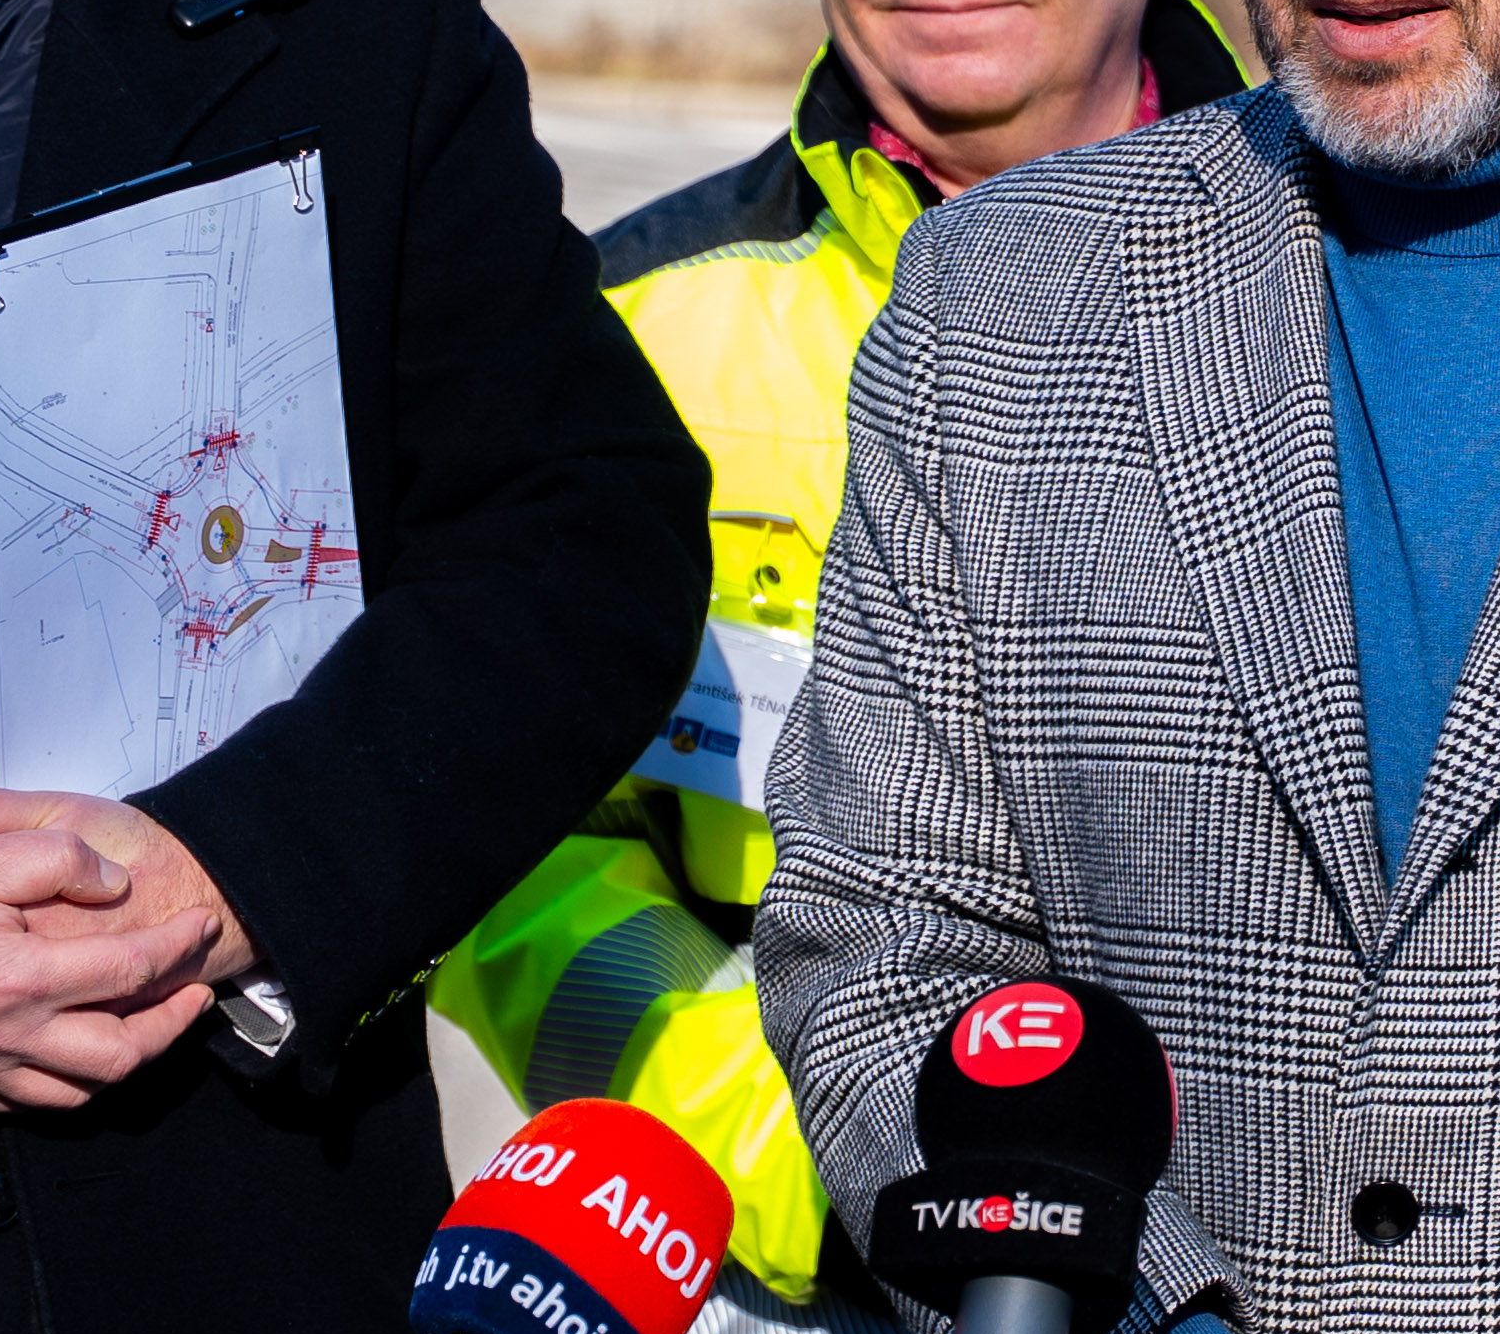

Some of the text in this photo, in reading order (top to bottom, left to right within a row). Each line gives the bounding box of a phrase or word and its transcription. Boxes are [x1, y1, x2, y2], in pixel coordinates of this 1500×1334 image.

[688, 681, 788, 716] rantišek TÉNA
[967, 1002, 1065, 1056] KE
[581, 1174, 712, 1299] AHOJ
[911, 1200, 956, 1232] TV
